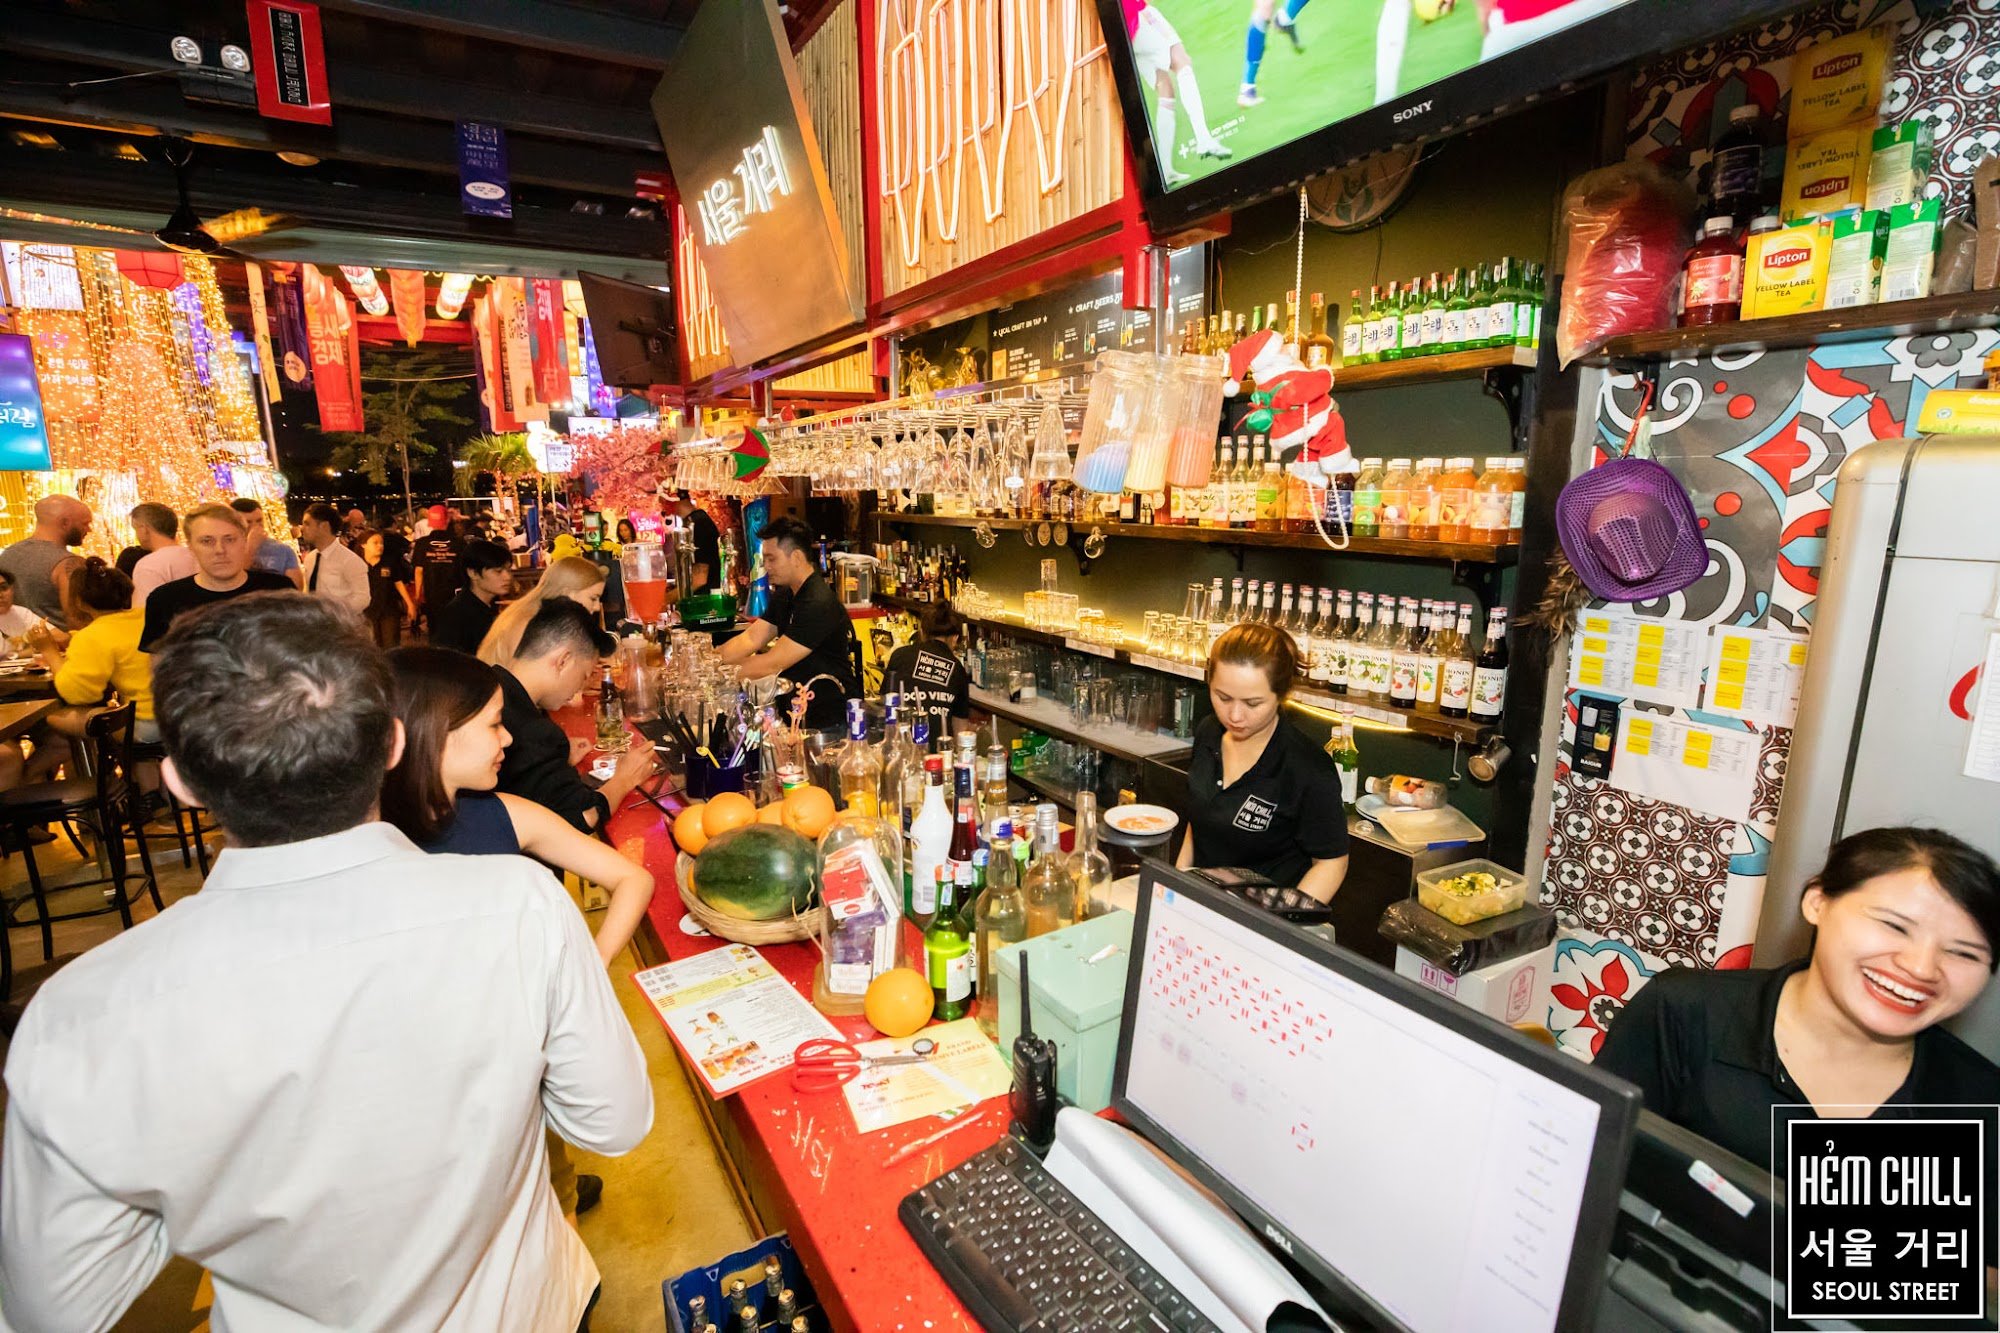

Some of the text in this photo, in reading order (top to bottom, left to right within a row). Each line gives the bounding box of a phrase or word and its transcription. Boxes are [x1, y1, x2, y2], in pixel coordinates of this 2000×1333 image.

[1815, 56, 1859, 78] Lipton
[1803, 82, 1867, 107] YELLOW LABEL
[1824, 98, 1841, 108] TEA
[1393, 100, 1433, 124] SONY
[1767, 251, 1808, 266] Lipton
[1756, 279, 1815, 293] YELLOW LABEL
[1075, 300, 1093, 313] CRAFT
[1094, 294, 1113, 310] BEERS
[699, 617, 728, 625] Heineken
[1478, 674, 1503, 682] MONIN
[928, 691, 955, 703] VIEW
[929, 706, 949, 717] OUT
[1266, 1223, 1293, 1254] DELL
